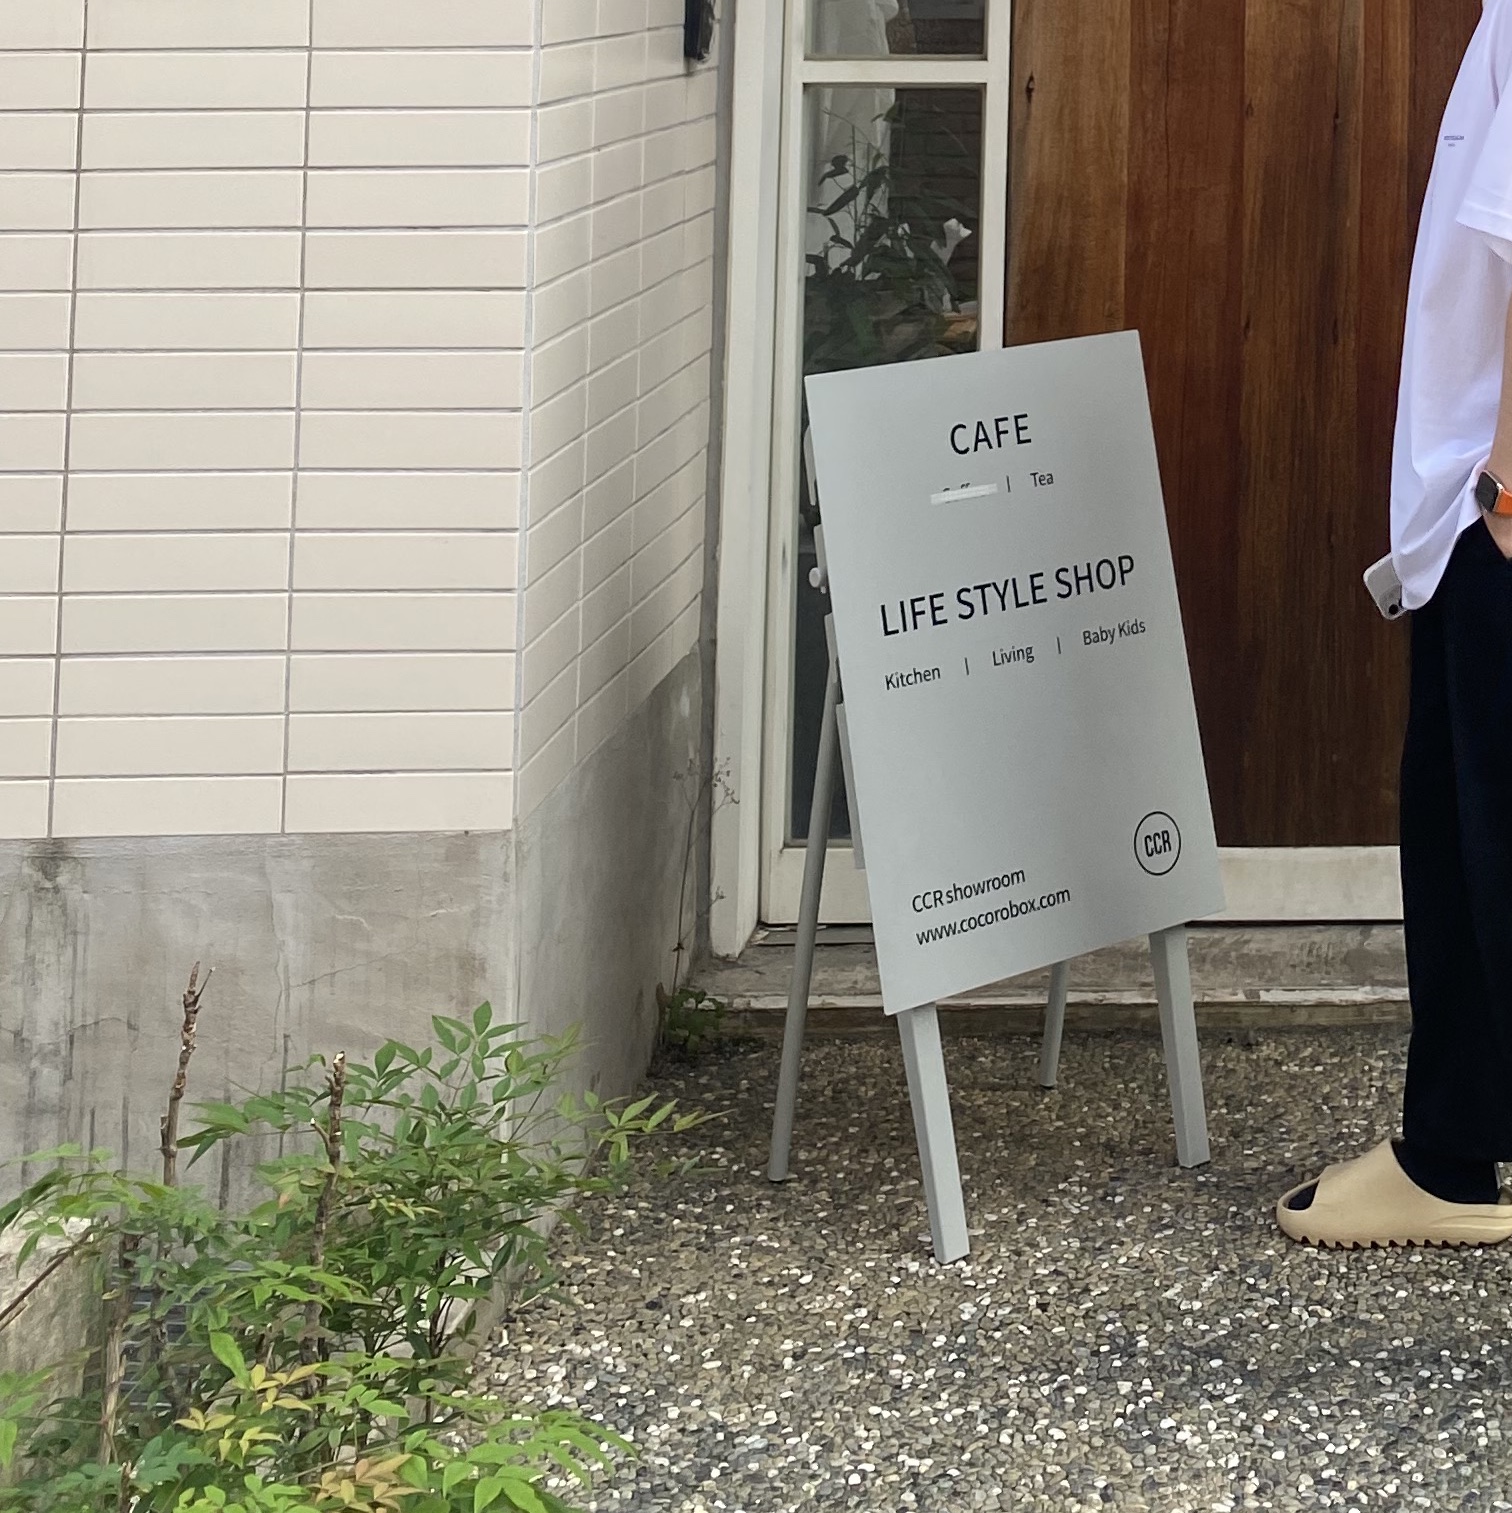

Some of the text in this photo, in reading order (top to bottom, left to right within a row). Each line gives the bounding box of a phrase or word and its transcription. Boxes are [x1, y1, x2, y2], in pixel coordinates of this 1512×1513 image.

[949, 412, 1033, 456] CAFE
[1029, 471, 1055, 488] Tea
[879, 554, 1136, 638] LIFE STYLE SHOP
[884, 618, 1147, 691] Kitchen Living Baby Kids
[1143, 829, 1173, 858] CCR
[911, 868, 1026, 914] CCR showroom
[915, 888, 1071, 947] www.cocorobox.com
